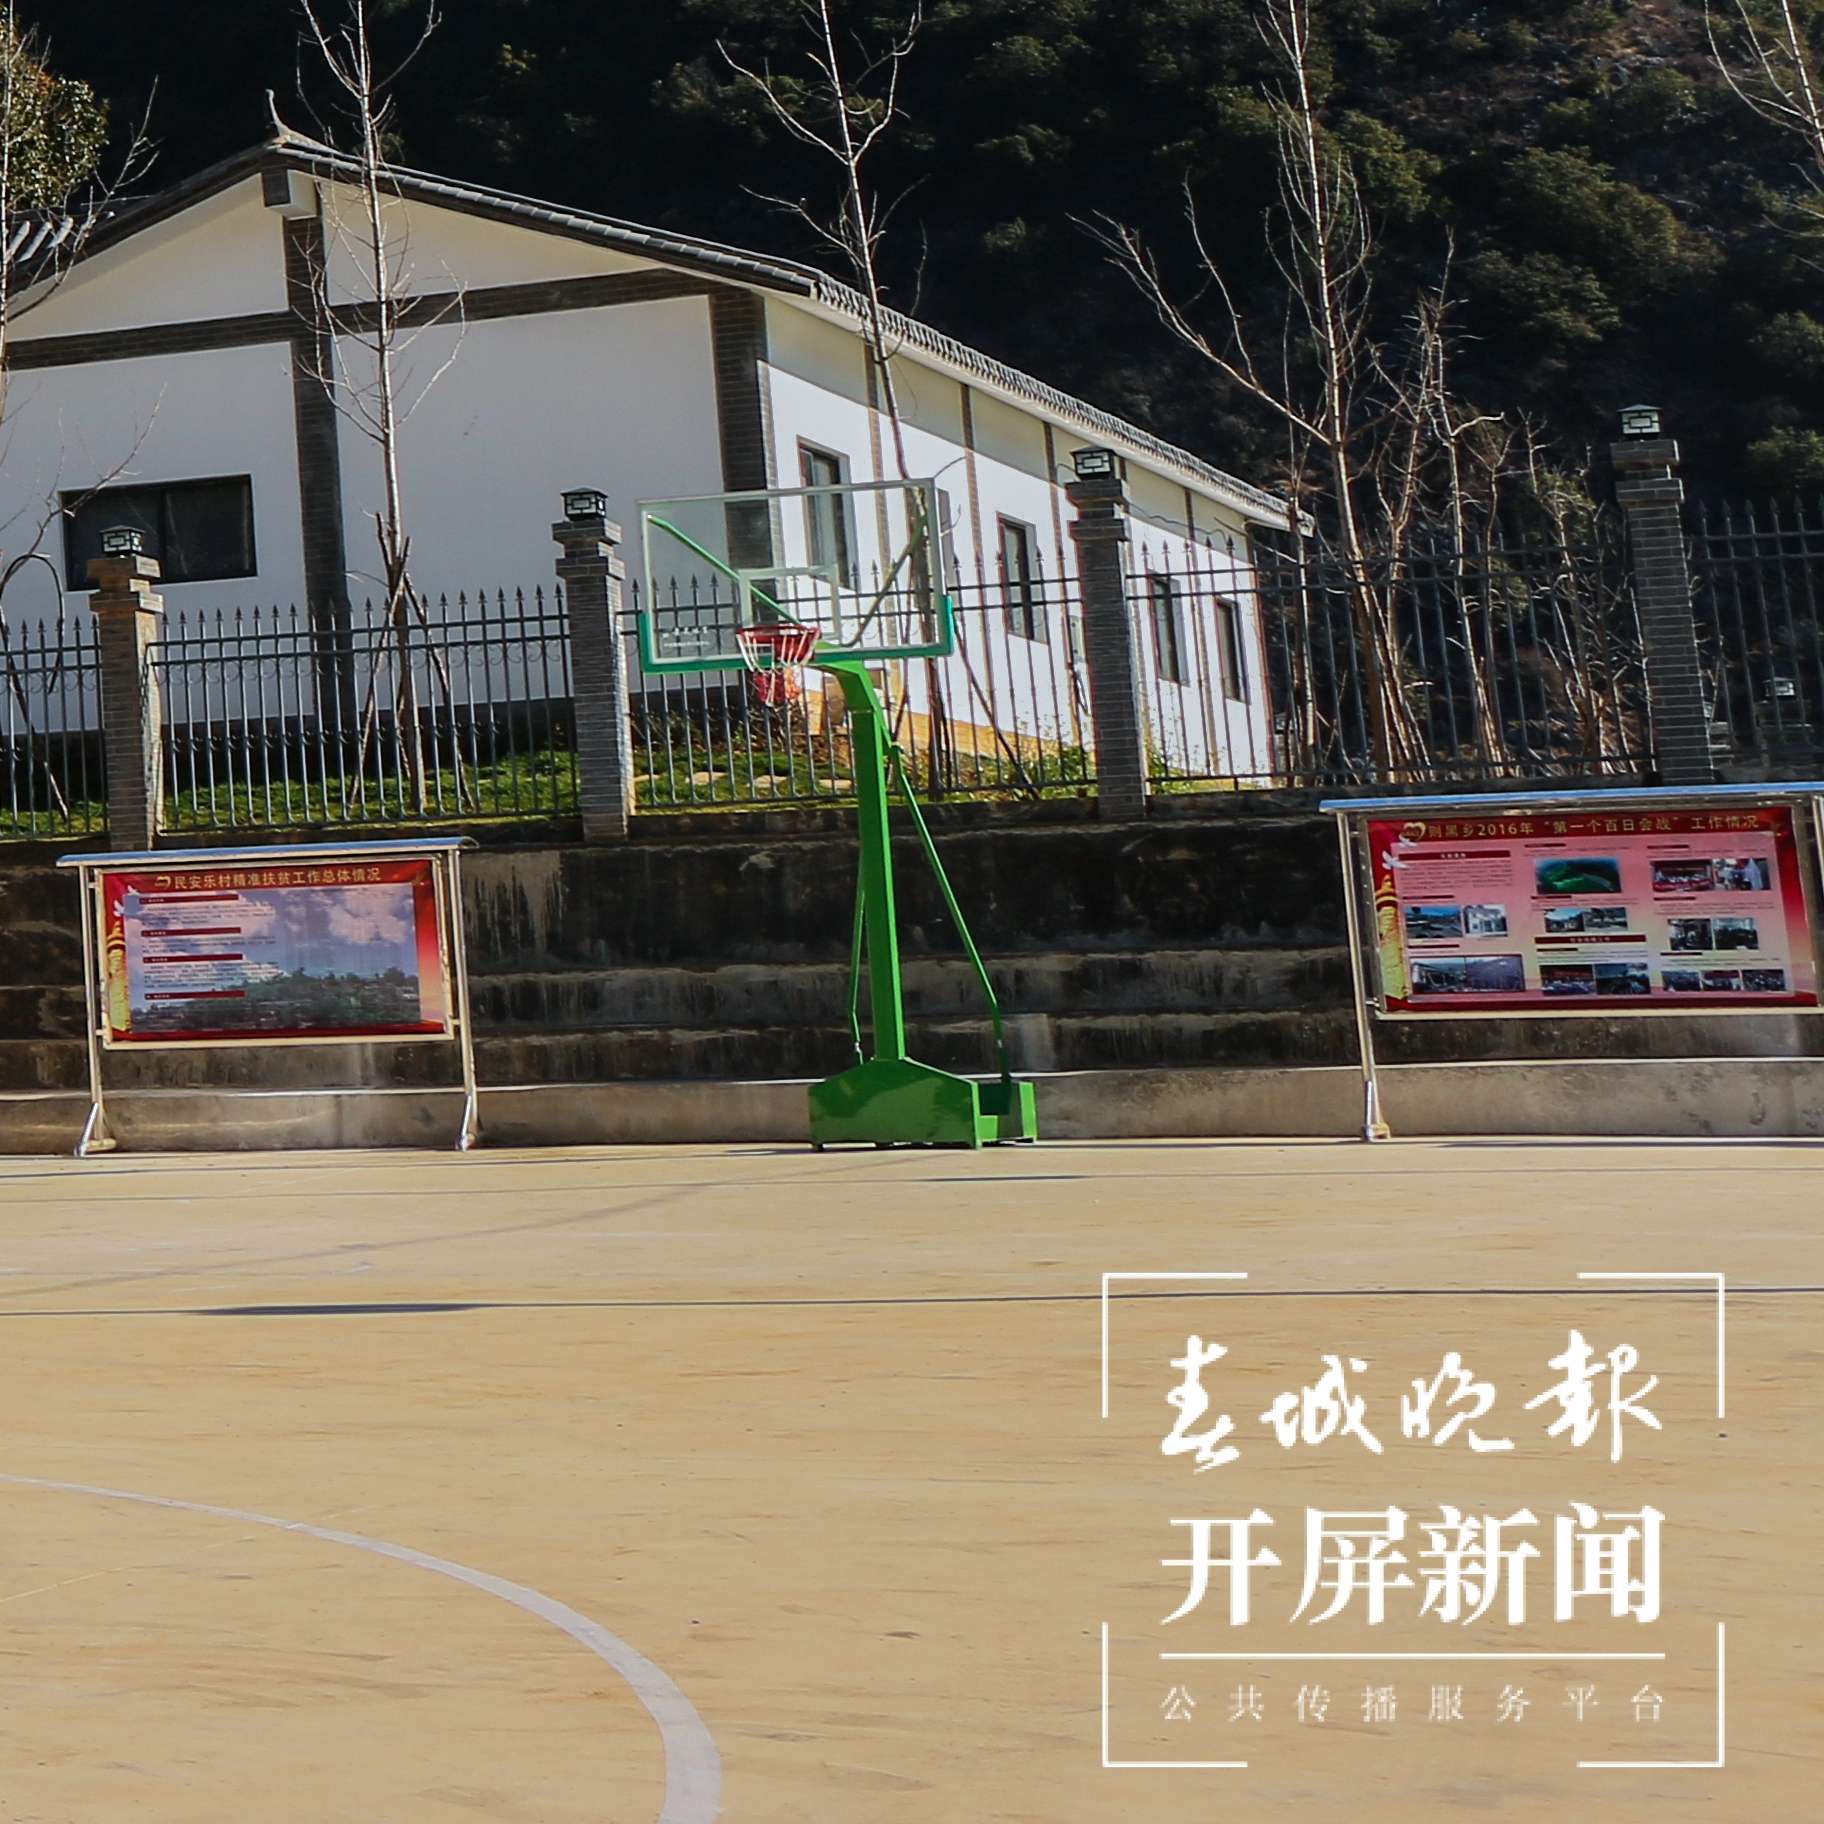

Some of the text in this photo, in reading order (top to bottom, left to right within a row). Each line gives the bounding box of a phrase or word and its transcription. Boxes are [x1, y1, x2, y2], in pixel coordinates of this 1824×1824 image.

[174, 867, 381, 890] 民安乐村精准扶贫工作总体情况
